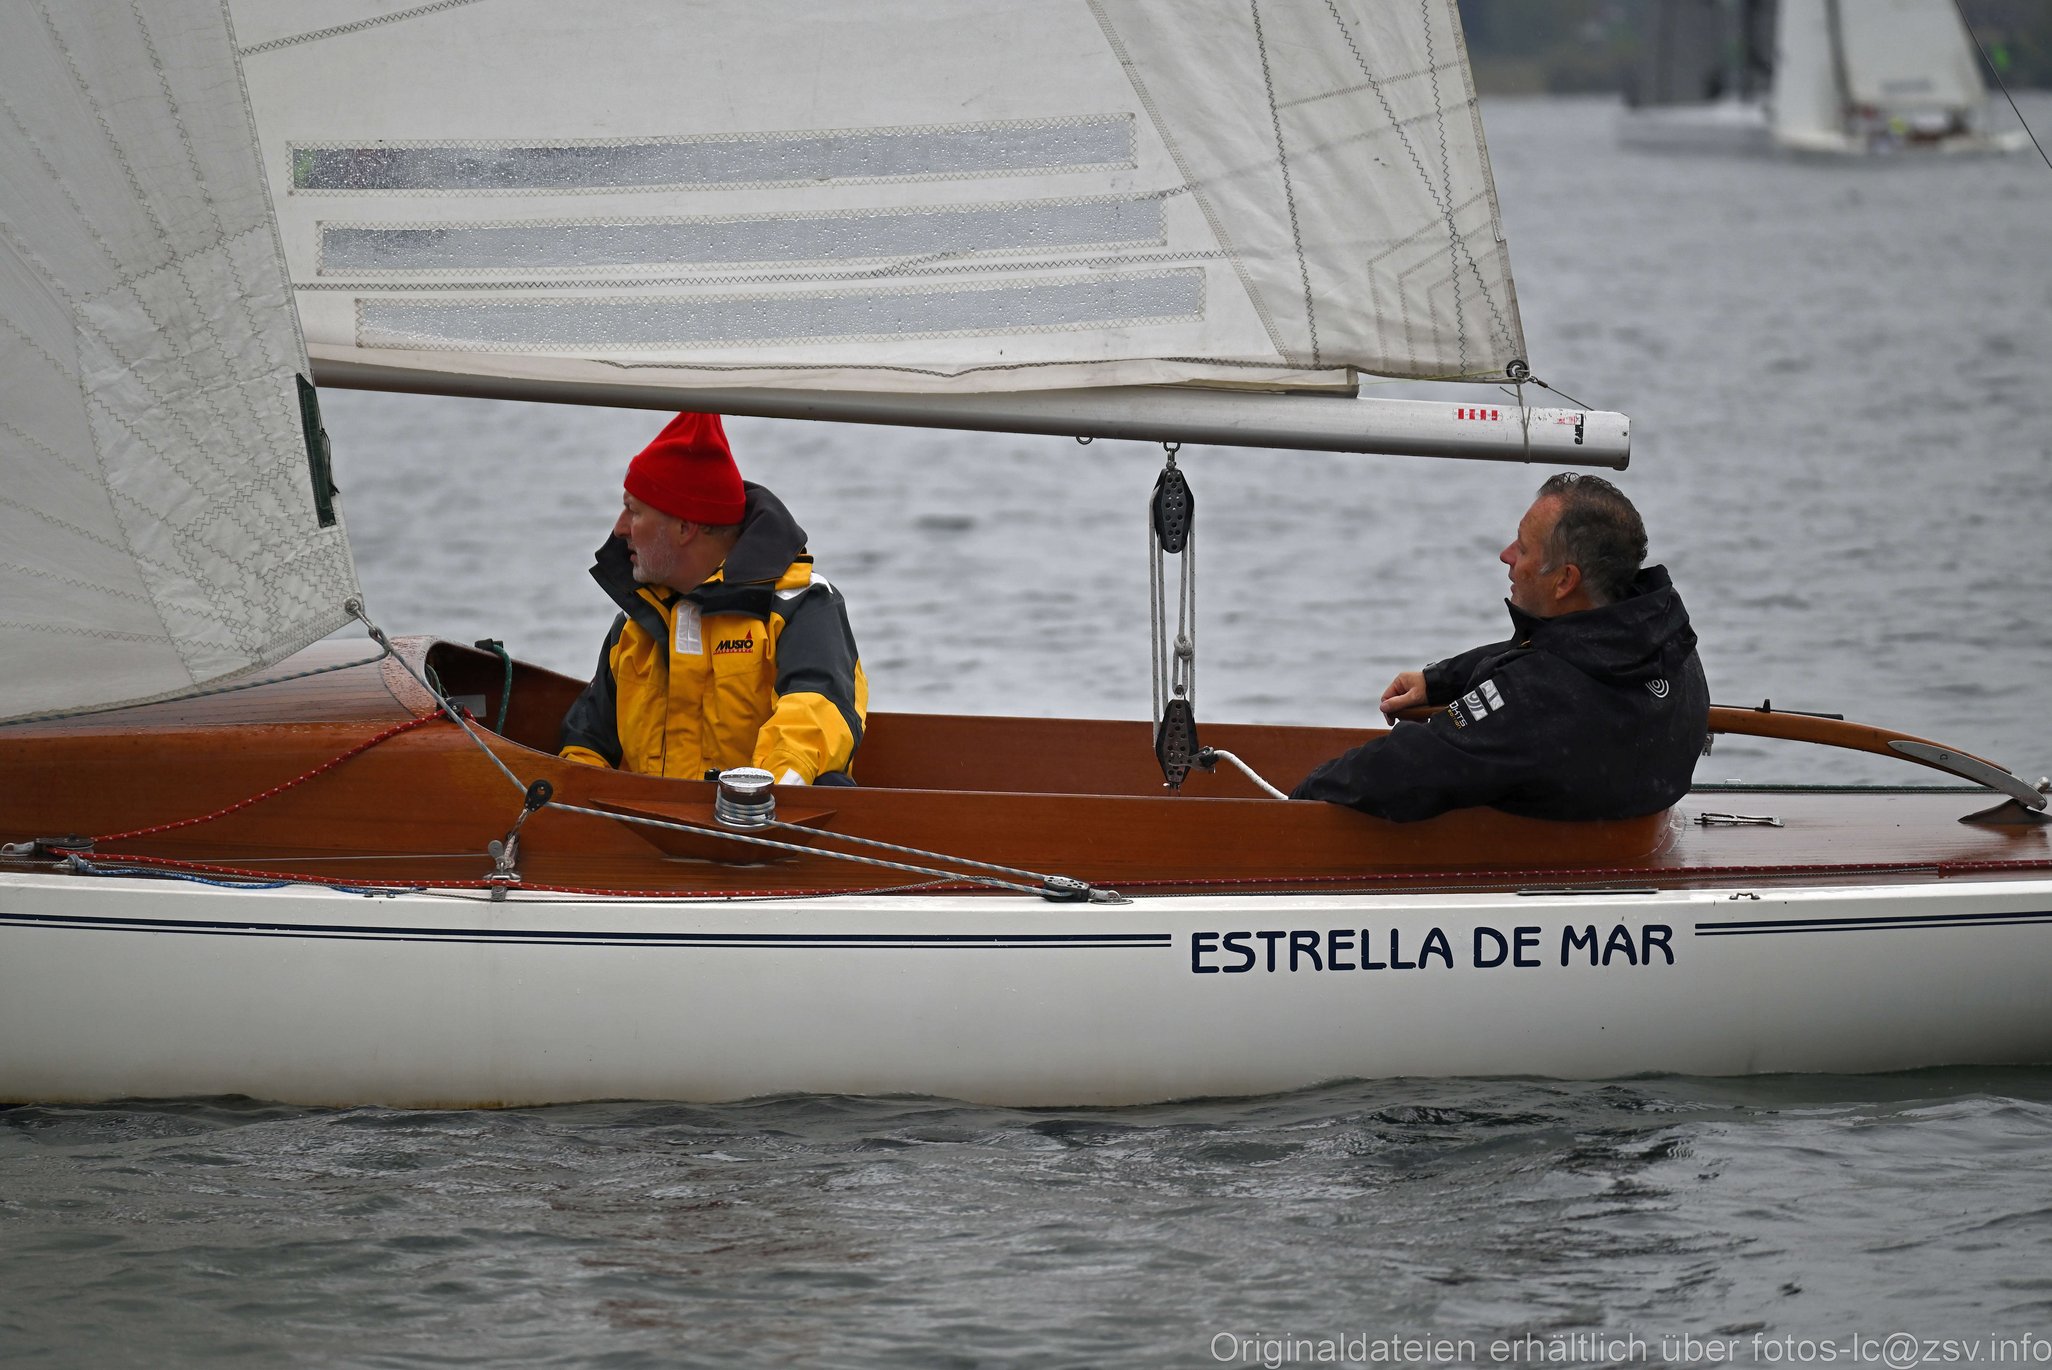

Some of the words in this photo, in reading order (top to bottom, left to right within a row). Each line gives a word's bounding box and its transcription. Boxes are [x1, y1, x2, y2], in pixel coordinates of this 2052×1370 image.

[715, 639, 754, 651] MUSTO
[1191, 927, 1454, 974] ESTRELLA
[1473, 926, 1542, 969] DE
[1560, 924, 1675, 967] MAR
